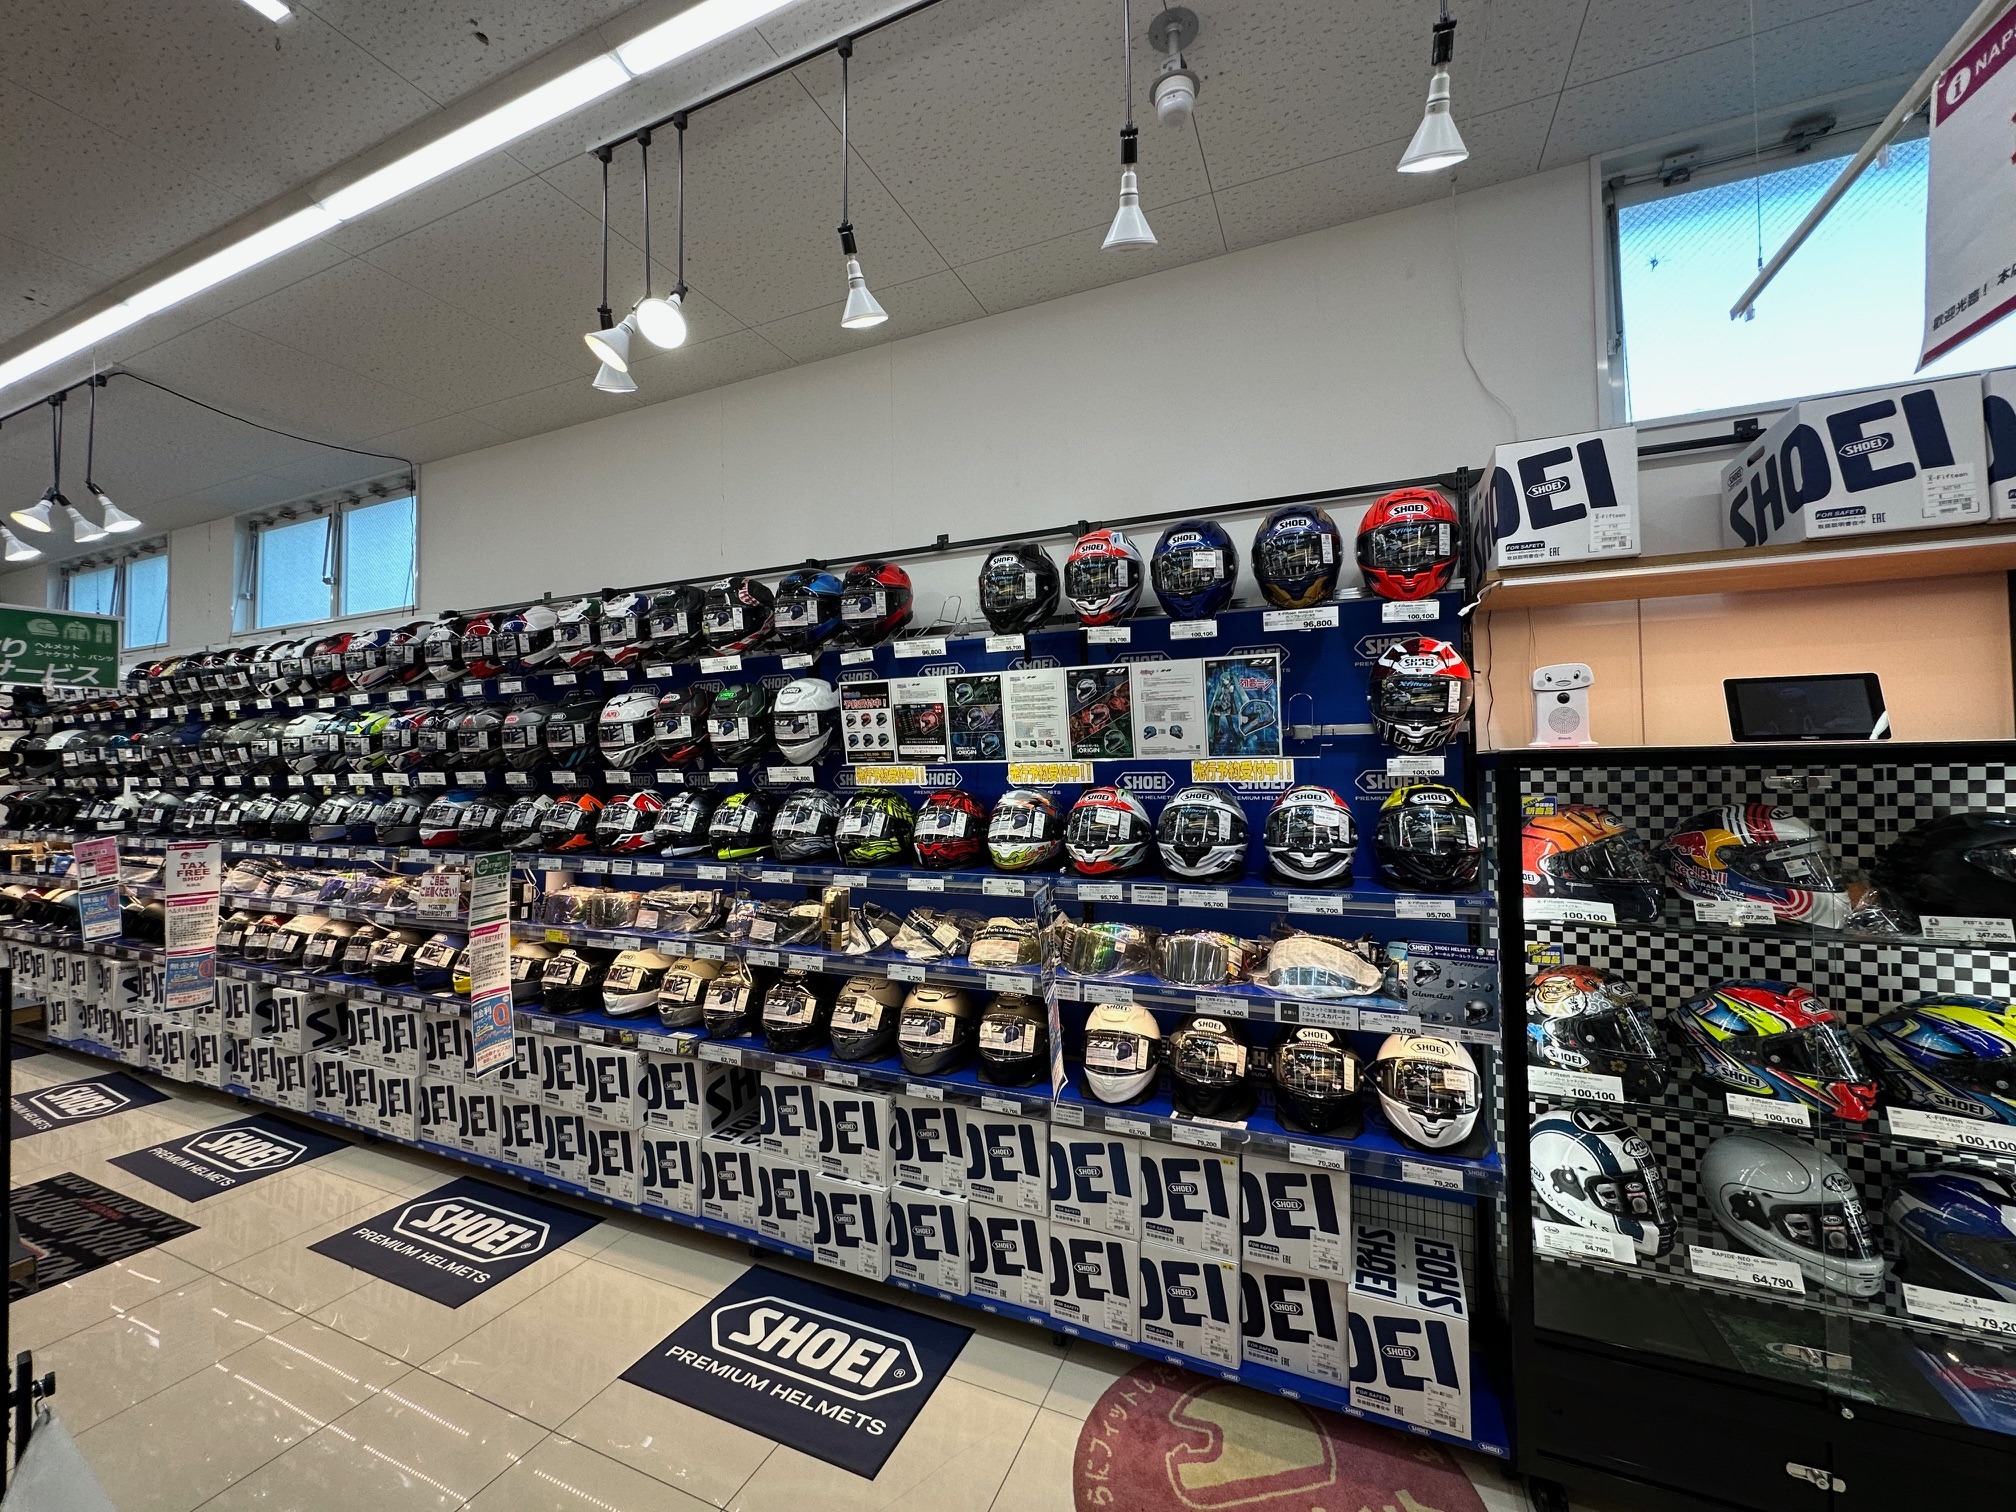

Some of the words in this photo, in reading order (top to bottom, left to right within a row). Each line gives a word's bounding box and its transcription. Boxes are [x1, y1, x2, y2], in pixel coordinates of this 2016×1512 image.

[1846, 438, 1882, 455] SHOEI
[1532, 479, 1561, 496] SHOEI
[1394, 505, 1424, 515] SHOEI
[1817, 510, 1834, 518] FOR
[1836, 507, 1865, 516] SAFETY
[1280, 519, 1307, 530] SHOEI
[1172, 533, 1196, 543] SHOEI
[1082, 544, 1103, 553] SHOEI
[993, 557, 1013, 565] SHOEI
[1303, 620, 1332, 628] 96,800
[35, 642, 79, 651] ヘルメット
[1124, 775, 1165, 789] SHOEI
[1295, 793, 1322, 801] SHOEI
[180, 861, 207, 869] TAX
[176, 868, 210, 877] FREE
[1563, 912, 1607, 922] 100,100
[1198, 1021, 1222, 1030] SHOEI
[1391, 1026, 1416, 1034] 29,700
[1303, 1031, 1328, 1040] SHOEI
[1088, 1040, 1113, 1048] Z-8
[1416, 1044, 1444, 1054] SHOEI
[720, 1057, 738, 1065] 62,700
[1722, 1067, 1759, 1087] SHOEI
[1571, 1088, 1615, 1101] 100,100
[45, 1087, 118, 1115] SHOEI
[1746, 1097, 1773, 1105] X-Fifteen
[1934, 1095, 1983, 1115] SHOEI
[1764, 1113, 1803, 1125] 100,100
[1925, 1114, 1963, 1124] X-Fifteen
[919, 1130, 937, 1138] SHOEI
[198, 1131, 293, 1167] SHOEI
[1629, 1140, 1645, 1152] Arai
[992, 1148, 1010, 1156] SHOEI
[149, 1147, 191, 1169] PREMIUM
[190, 1164, 236, 1187] HELMETS
[1433, 1180, 1459, 1188] 79,200
[1276, 1200, 1299, 1209] SHOEI
[410, 1204, 537, 1256] SHOEI
[915, 1227, 931, 1235] SHOEI
[995, 1242, 1013, 1250] SHOEI
[353, 1228, 418, 1258] PREMIUM
[418, 1251, 491, 1284] HELMETS
[1712, 1251, 1751, 1262] RAPIDE-NEO
[1355, 1226, 1398, 1298] SHOEI
[1077, 1265, 1097, 1273] SHOEI
[1414, 1237, 1464, 1315] SHOEI
[1752, 1273, 1794, 1288] 64,790
[1170, 1288, 1194, 1297] SHOEI
[1274, 1302, 1297, 1312] SHOEI
[728, 1308, 901, 1388] SHOEI
[1386, 1346, 1412, 1357] SHOEI
[665, 1345, 769, 1391] PREMIUM
[770, 1383, 887, 1435] HELMETS
